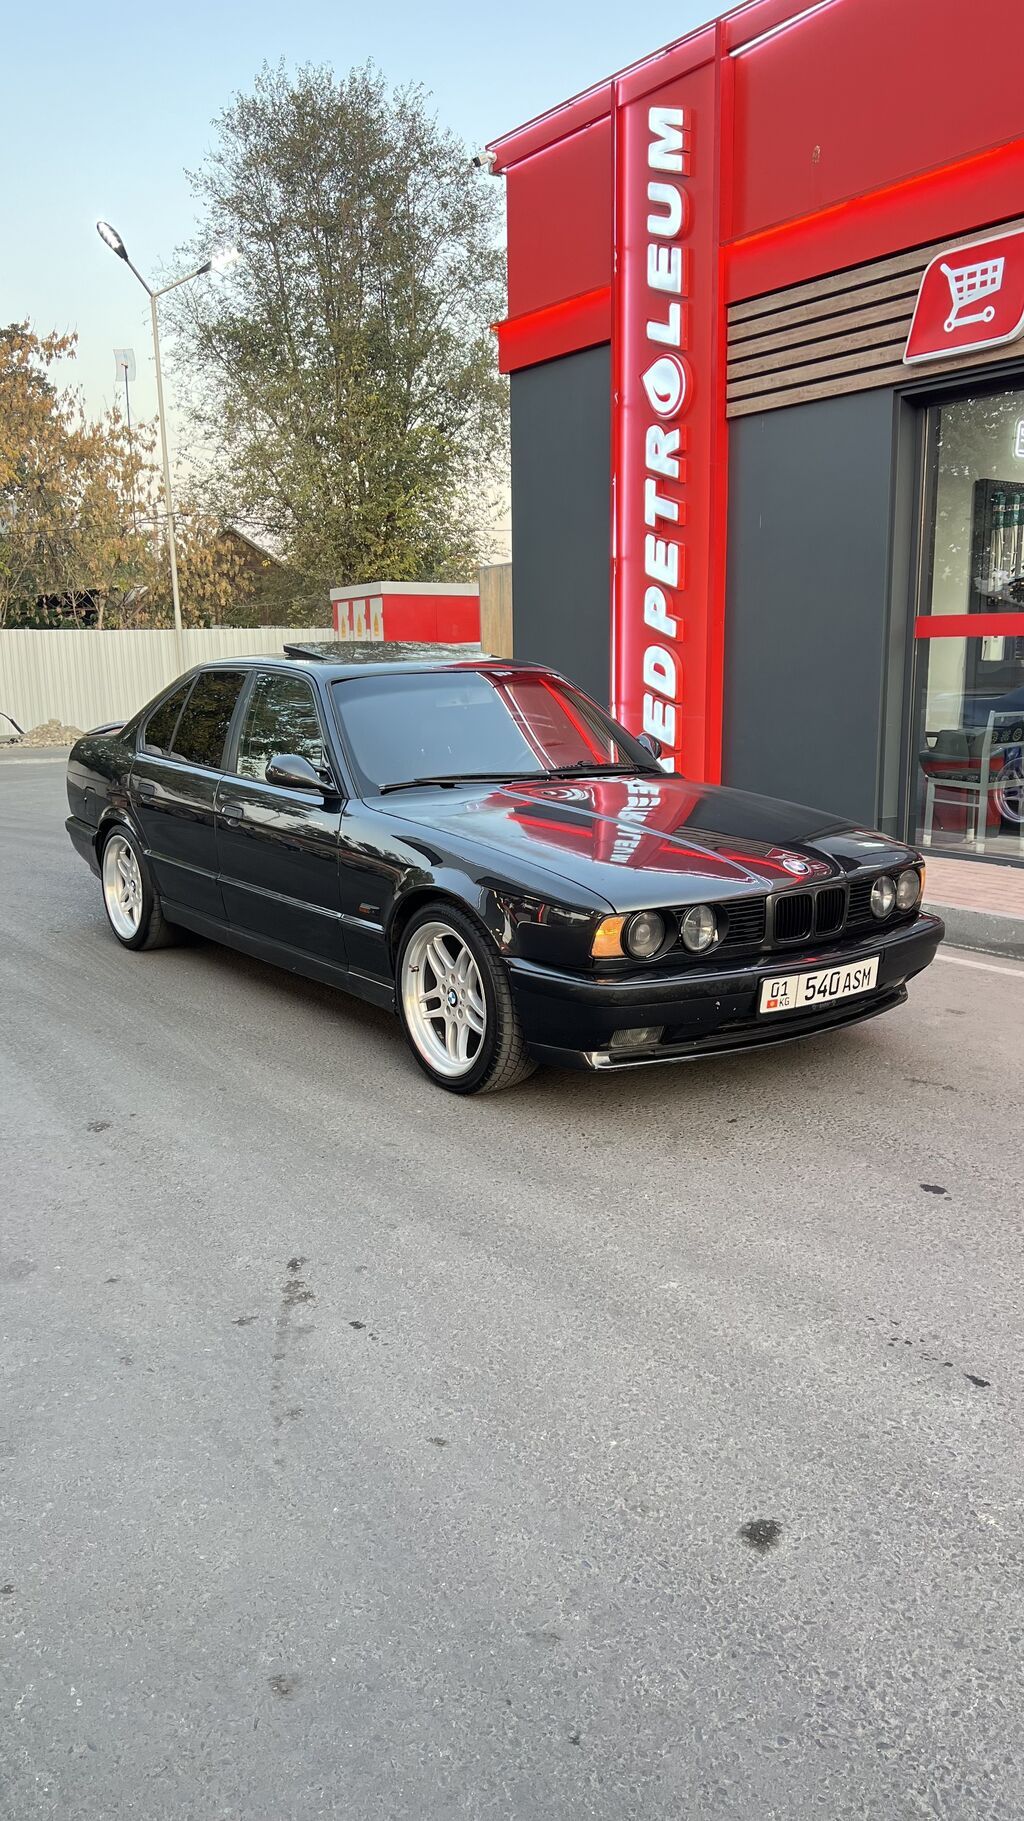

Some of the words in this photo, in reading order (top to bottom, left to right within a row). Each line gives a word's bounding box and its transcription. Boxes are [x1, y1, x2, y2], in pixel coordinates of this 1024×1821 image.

[643, 645, 679, 773] ED
[770, 981, 788, 998] 01
[804, 971, 840, 1001] 540
[842, 966, 872, 993] ASM
[778, 996, 790, 1007] KG
